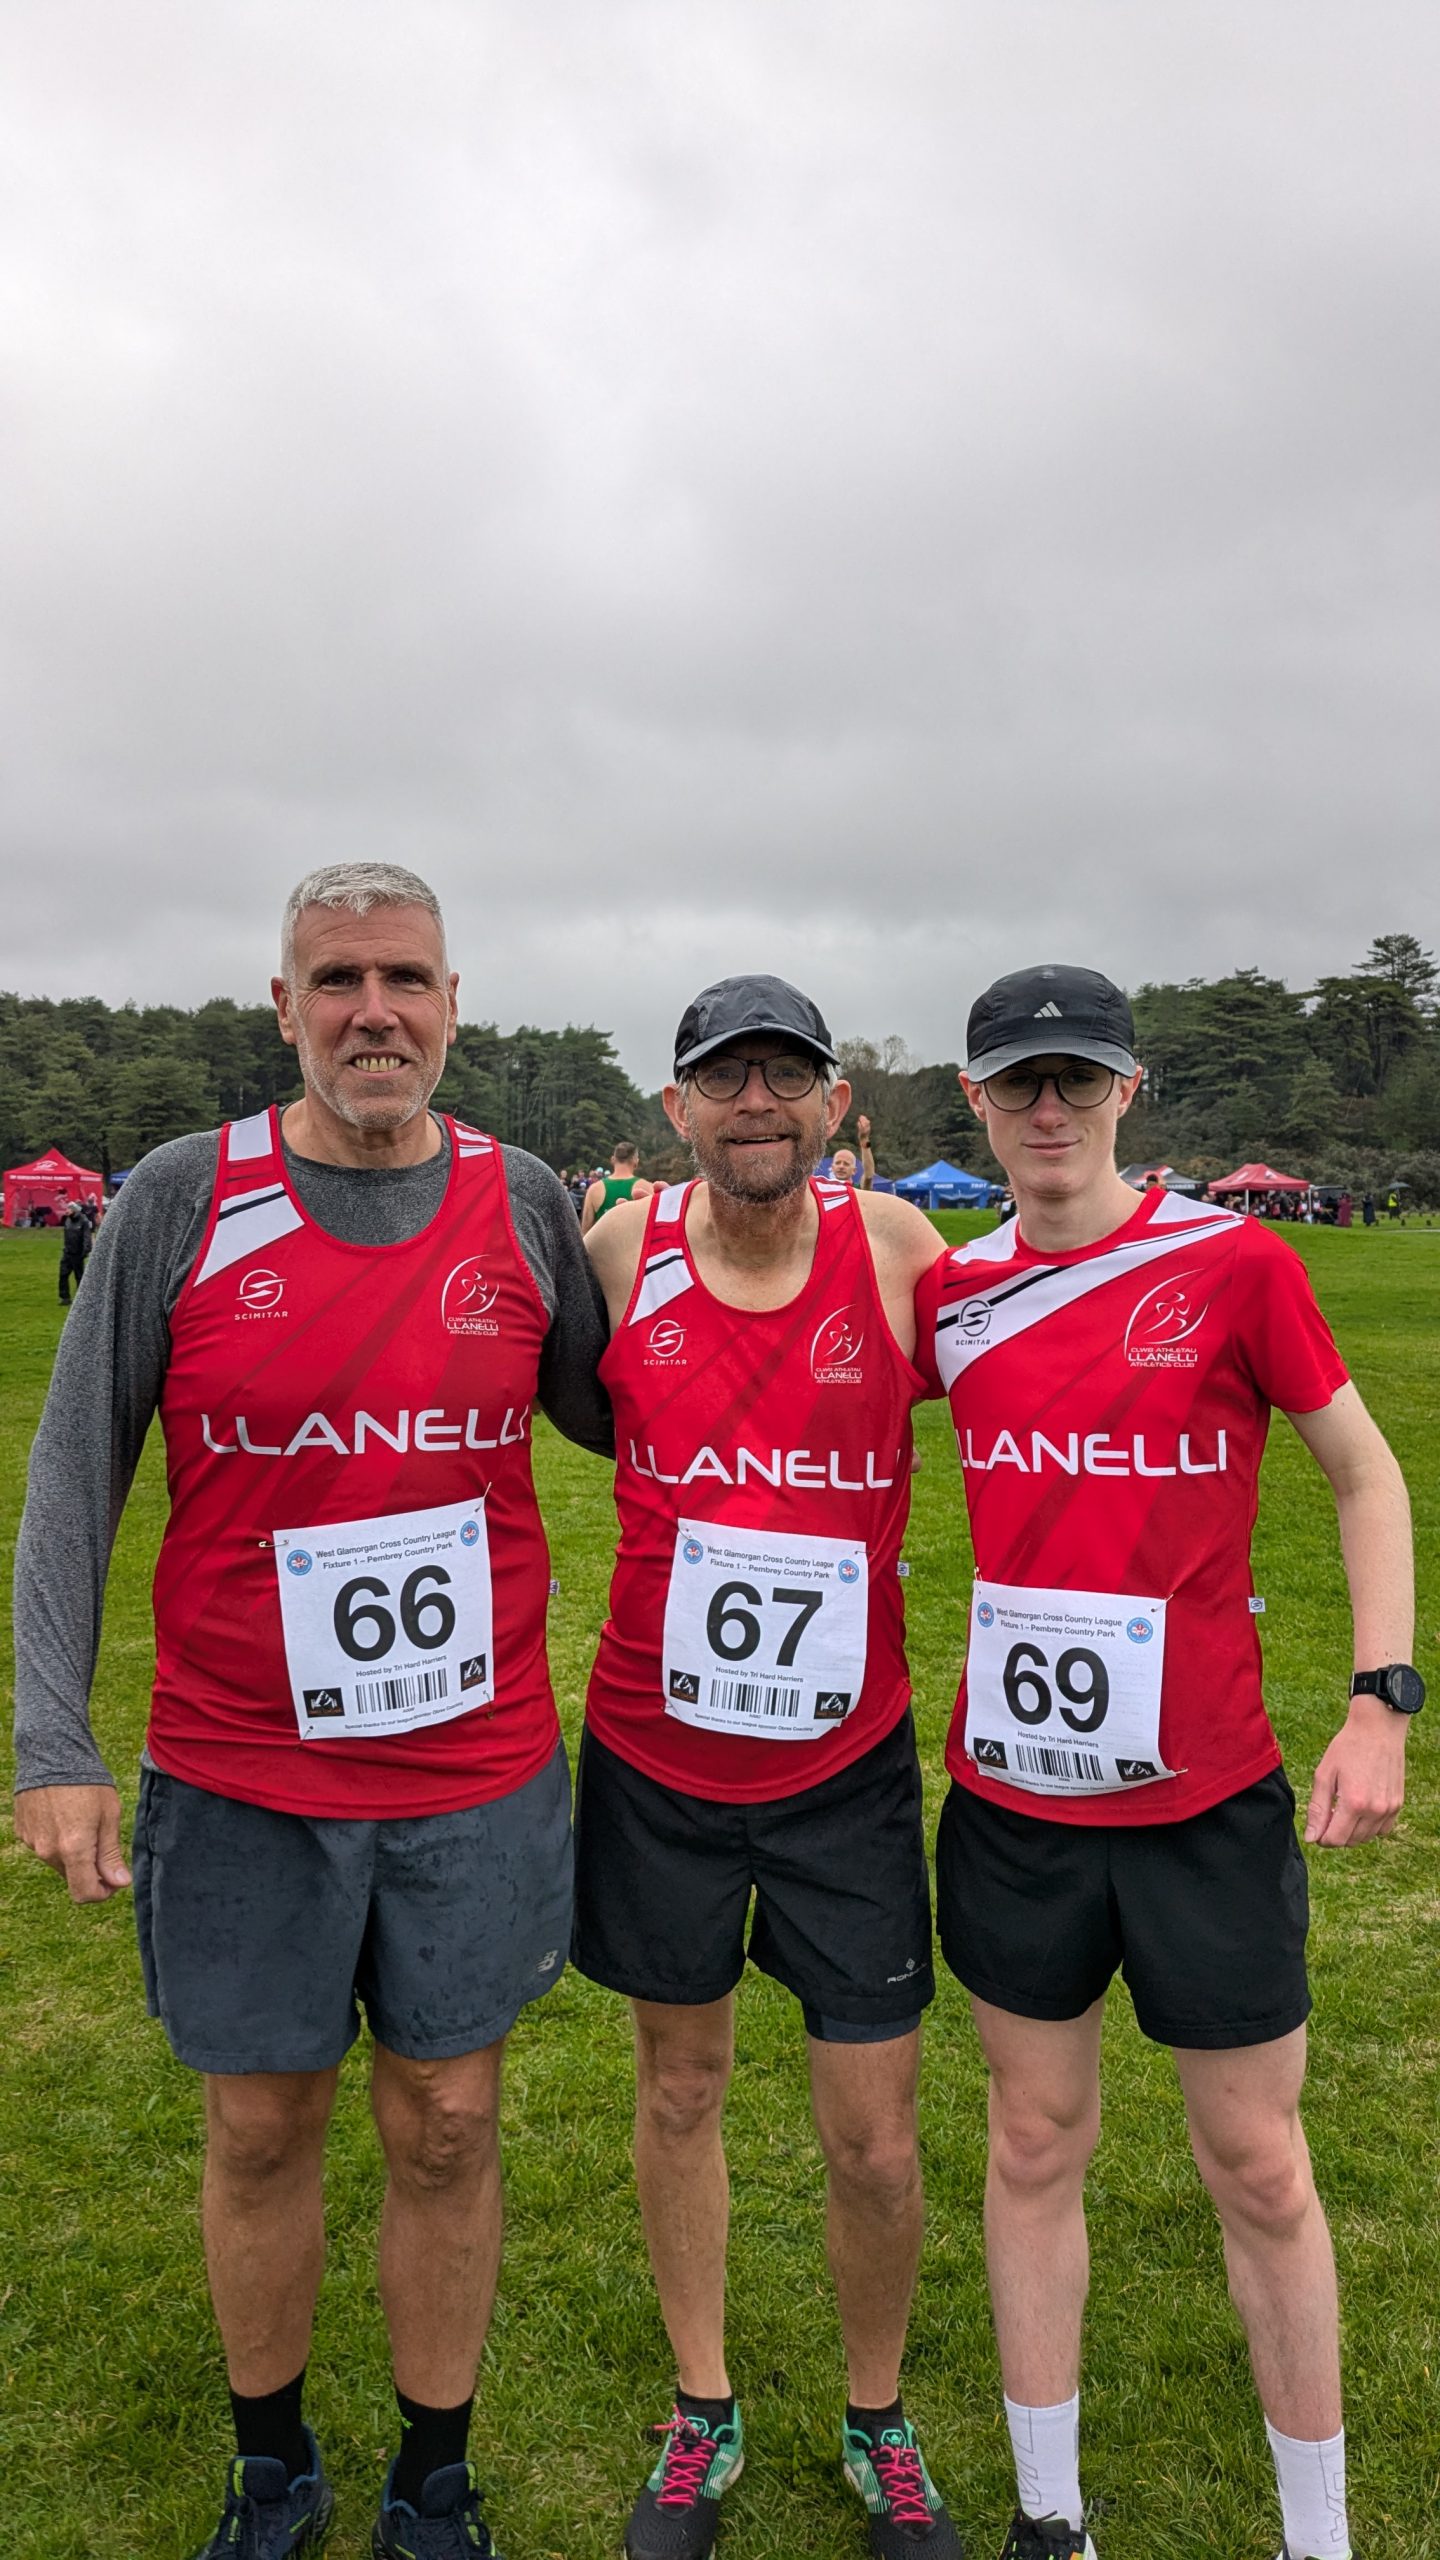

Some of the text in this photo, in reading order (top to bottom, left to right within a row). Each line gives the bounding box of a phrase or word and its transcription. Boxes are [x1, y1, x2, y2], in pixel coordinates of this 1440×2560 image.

[235, 1311, 288, 1320] SCIMITAR
[447, 1322, 499, 1331] LLANELLI
[1128, 1353, 1198, 1362] LLANELLI
[201, 1404, 528, 1456] LLANELLI
[316, 1530, 456, 1558] West Glamorgan Cross Country League
[323, 1561, 351, 1569] Fixture
[367, 1553, 402, 1563] Pembrey
[404, 1547, 435, 1556] Country
[436, 1542, 452, 1550] Park
[708, 1546, 834, 1569] West Glamorgan Cross Country League
[710, 1558, 734, 1568] Fixture
[748, 1564, 782, 1576] Pembrey
[784, 1568, 812, 1578] Country
[334, 1565, 456, 1662] 66
[707, 1581, 823, 1666] 67
[996, 1608, 1122, 1627] West Glamorgan Cross Country League
[1001, 1620, 1018, 1629] Fixture
[1031, 1624, 1062, 1634] Pembrey
[1064, 1626, 1095, 1637] Country
[1097, 1629, 1115, 1638] Park
[356, 1668, 382, 1677] Hosted
[404, 1661, 420, 1669] Hard
[422, 1655, 447, 1665] Harriers
[716, 1666, 739, 1675] Hosted
[1003, 1642, 1109, 1733] 69
[1018, 1731, 1038, 1740] Hosted
[1074, 1738, 1099, 1748] Harriers
